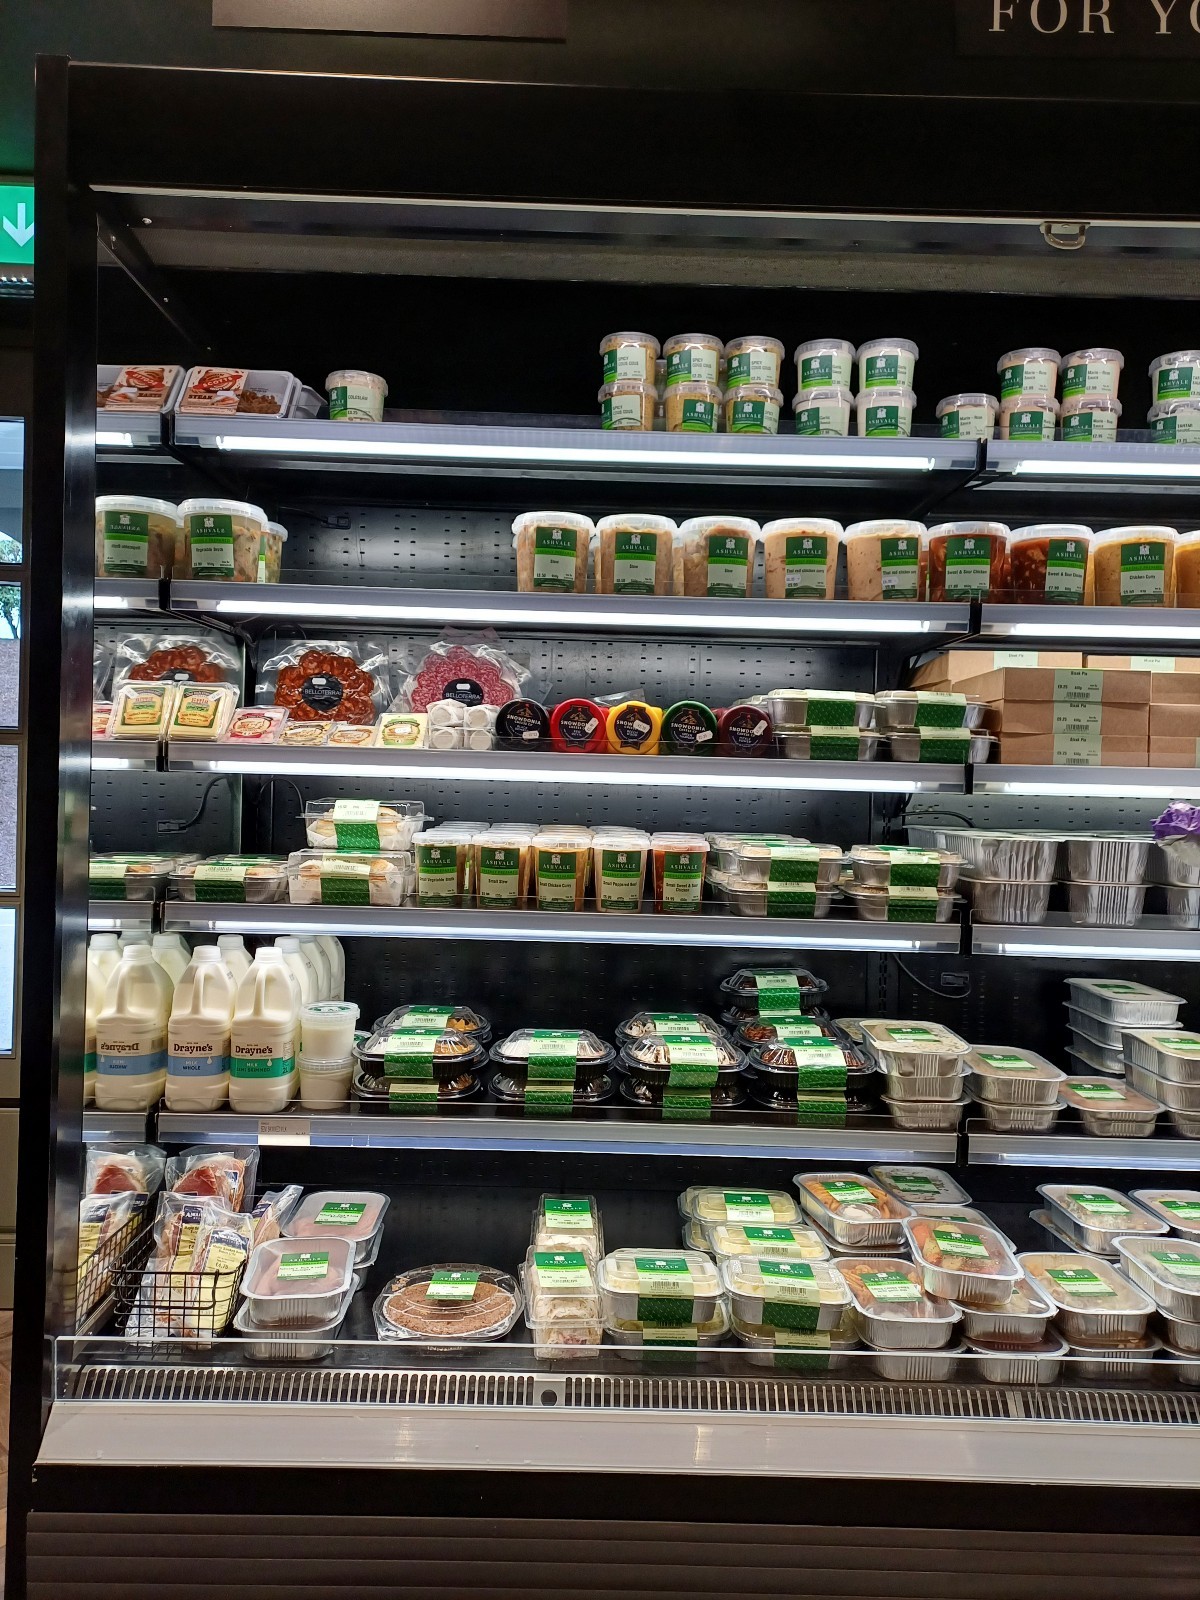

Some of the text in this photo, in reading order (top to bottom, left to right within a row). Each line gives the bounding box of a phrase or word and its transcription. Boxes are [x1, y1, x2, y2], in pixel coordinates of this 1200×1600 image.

[989, 0, 1200, 34] FOR Y
[868, 367, 895, 375] ASHVALE
[542, 539, 571, 547] ASHVALE
[715, 548, 744, 556] ASHVALE
[304, 688, 341, 696] BELLOTERRA
[506, 714, 541, 726] SNOWDONIA
[671, 722, 706, 731] SNOWDONIA
[173, 1043, 213, 1055] Drayne's
[235, 1045, 273, 1056] Drayne's
